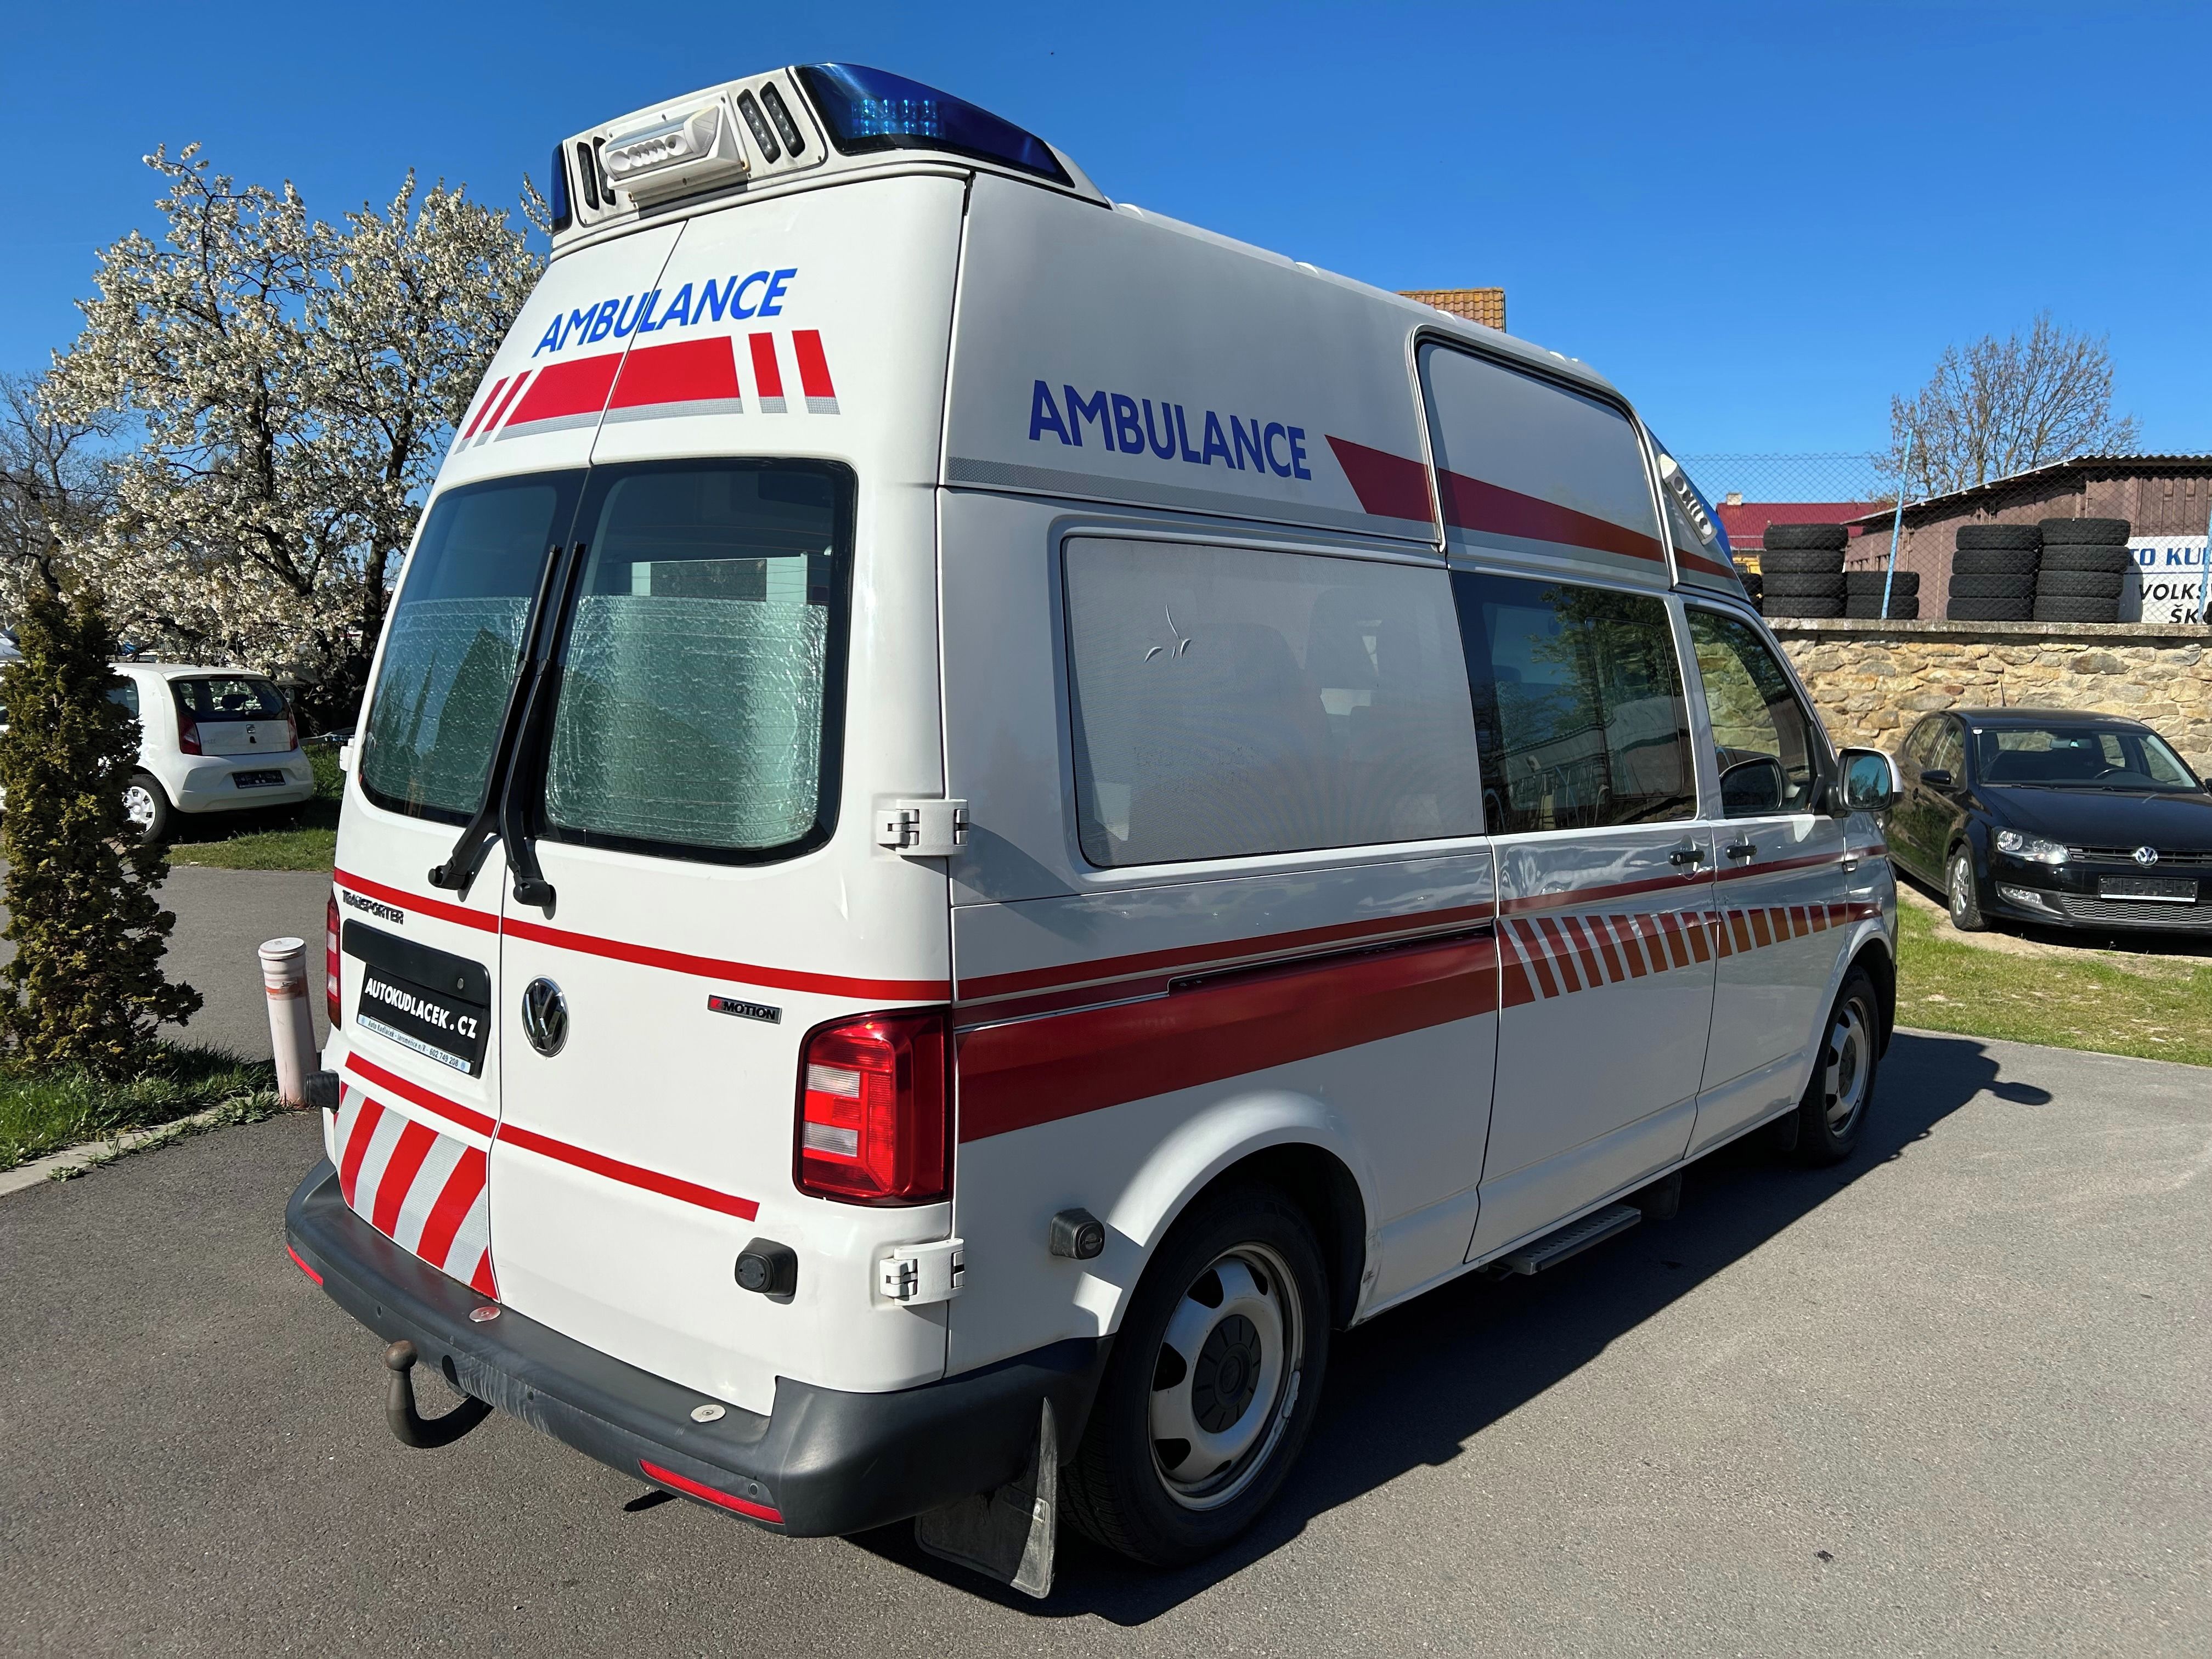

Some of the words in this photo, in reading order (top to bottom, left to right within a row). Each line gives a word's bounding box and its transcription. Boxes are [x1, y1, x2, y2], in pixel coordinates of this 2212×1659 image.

[532, 268, 798, 358] AMBULANCE
[1029, 380, 1312, 481] AMBULANCE
[342, 889, 404, 925] TRANSPORTER
[429, 1048, 439, 1058] 602
[439, 1052, 449, 1063] 749
[449, 1057, 459, 1067] 208
